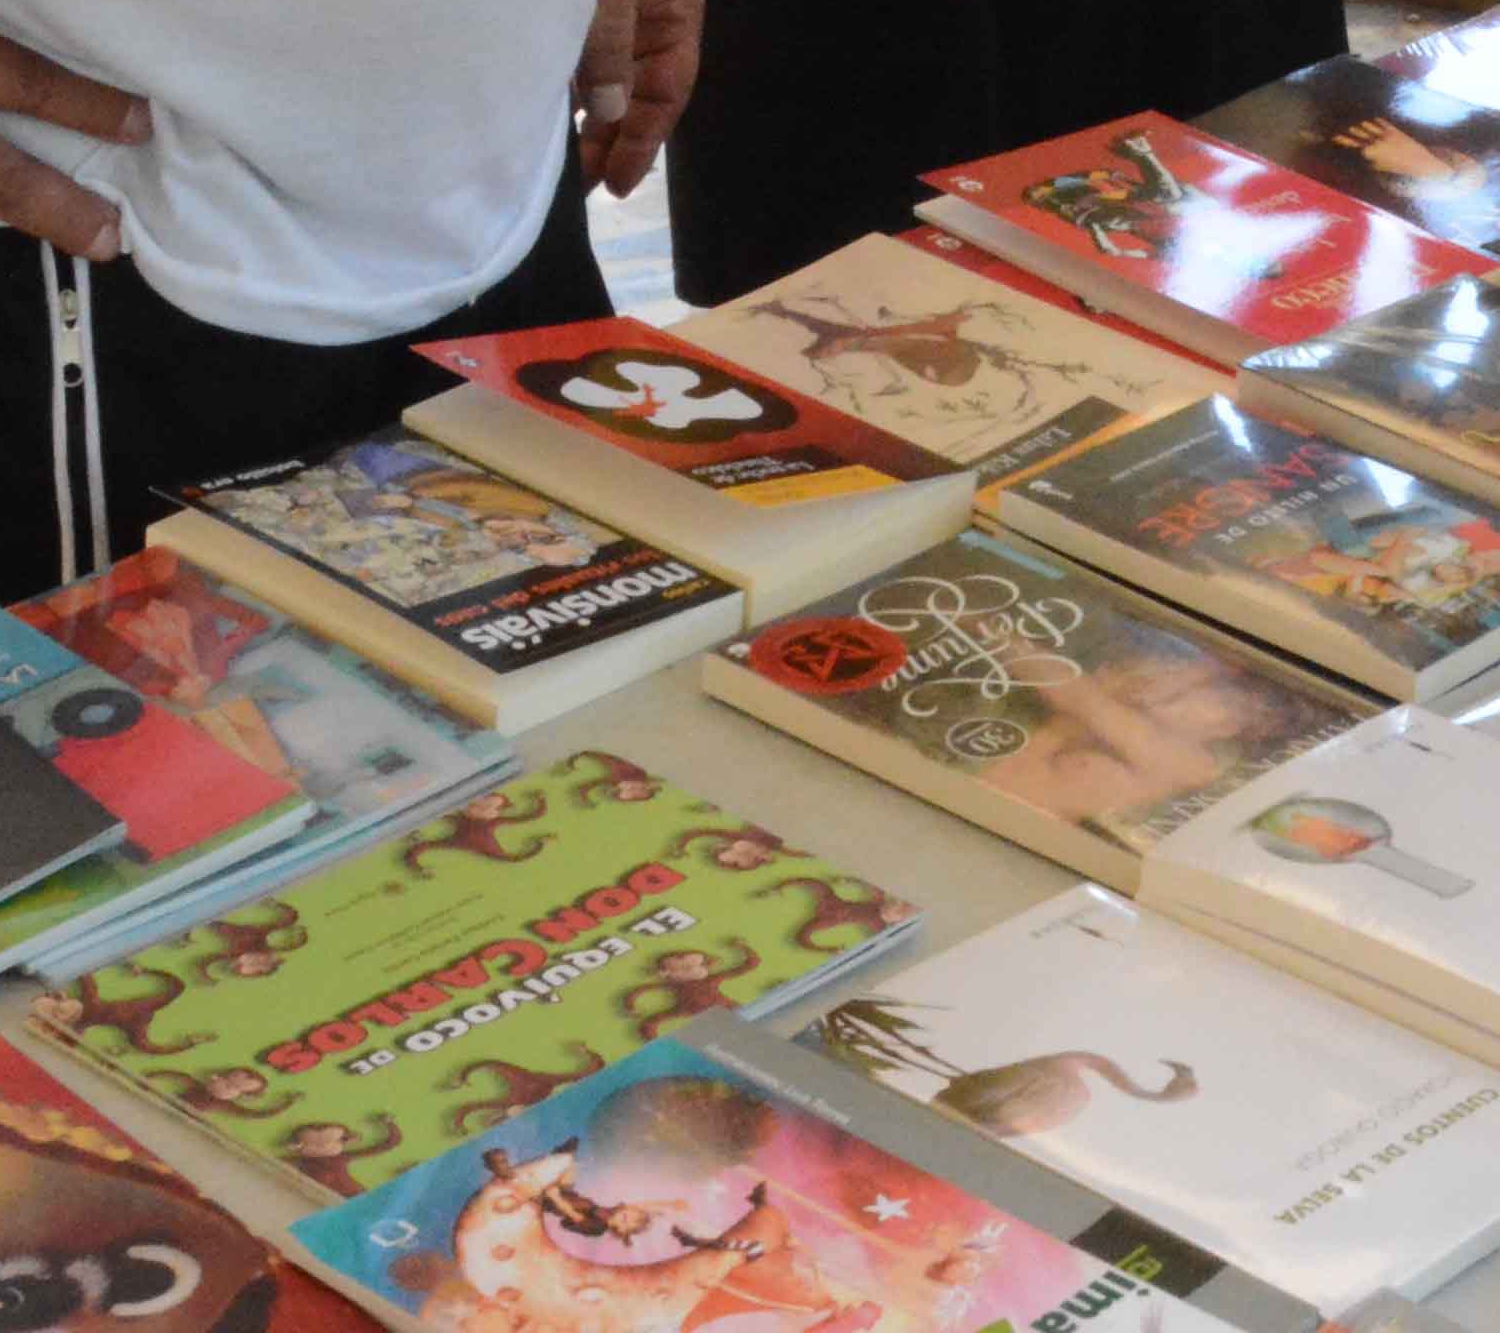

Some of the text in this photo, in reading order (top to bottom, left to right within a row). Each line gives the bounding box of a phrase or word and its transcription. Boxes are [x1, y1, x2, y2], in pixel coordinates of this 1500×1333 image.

[1209, 525, 1250, 544] DE
[451, 561, 717, 658] monsiváis
[962, 725, 1021, 755] 30
[518, 859, 693, 947] DON
[263, 929, 562, 1075] CARLOS
[387, 931, 653, 1065] EQUÍVOCO
[342, 1046, 402, 1077] DE
[1334, 1159, 1384, 1187] LA
[1366, 1141, 1413, 1167] DE
[1265, 1179, 1352, 1229] SELVA
